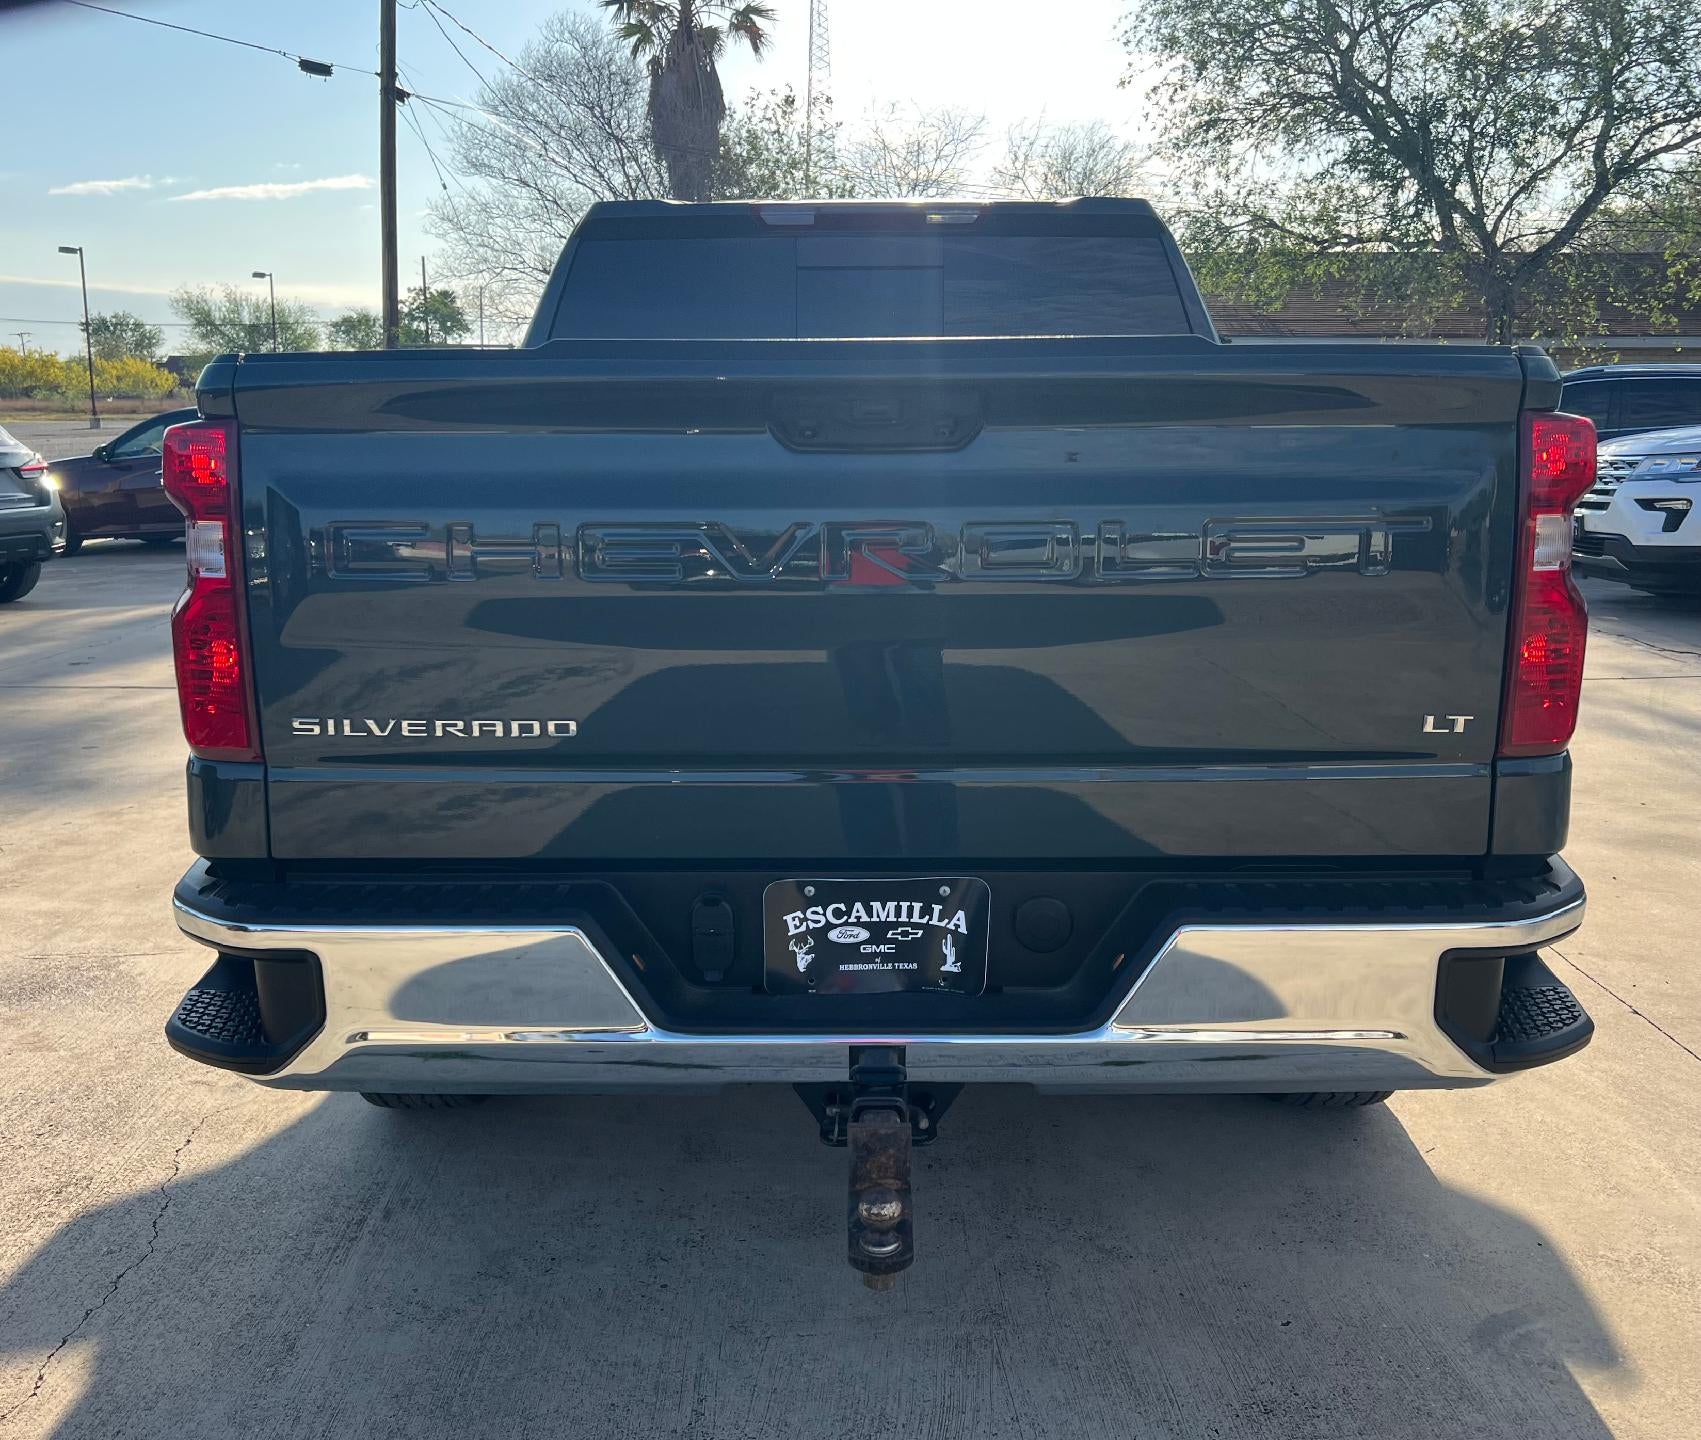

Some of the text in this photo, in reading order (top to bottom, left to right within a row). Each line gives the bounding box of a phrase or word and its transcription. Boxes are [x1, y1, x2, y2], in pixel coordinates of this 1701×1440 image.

[326, 514, 1434, 583] CHEVROLET
[291, 718, 578, 738] SILVERADO
[1423, 714, 1474, 733] LT
[783, 901, 968, 936] ESCAMILLA
[860, 944, 896, 953] GMC
[839, 962, 918, 971] HEBBRONVILLE TEXAS
